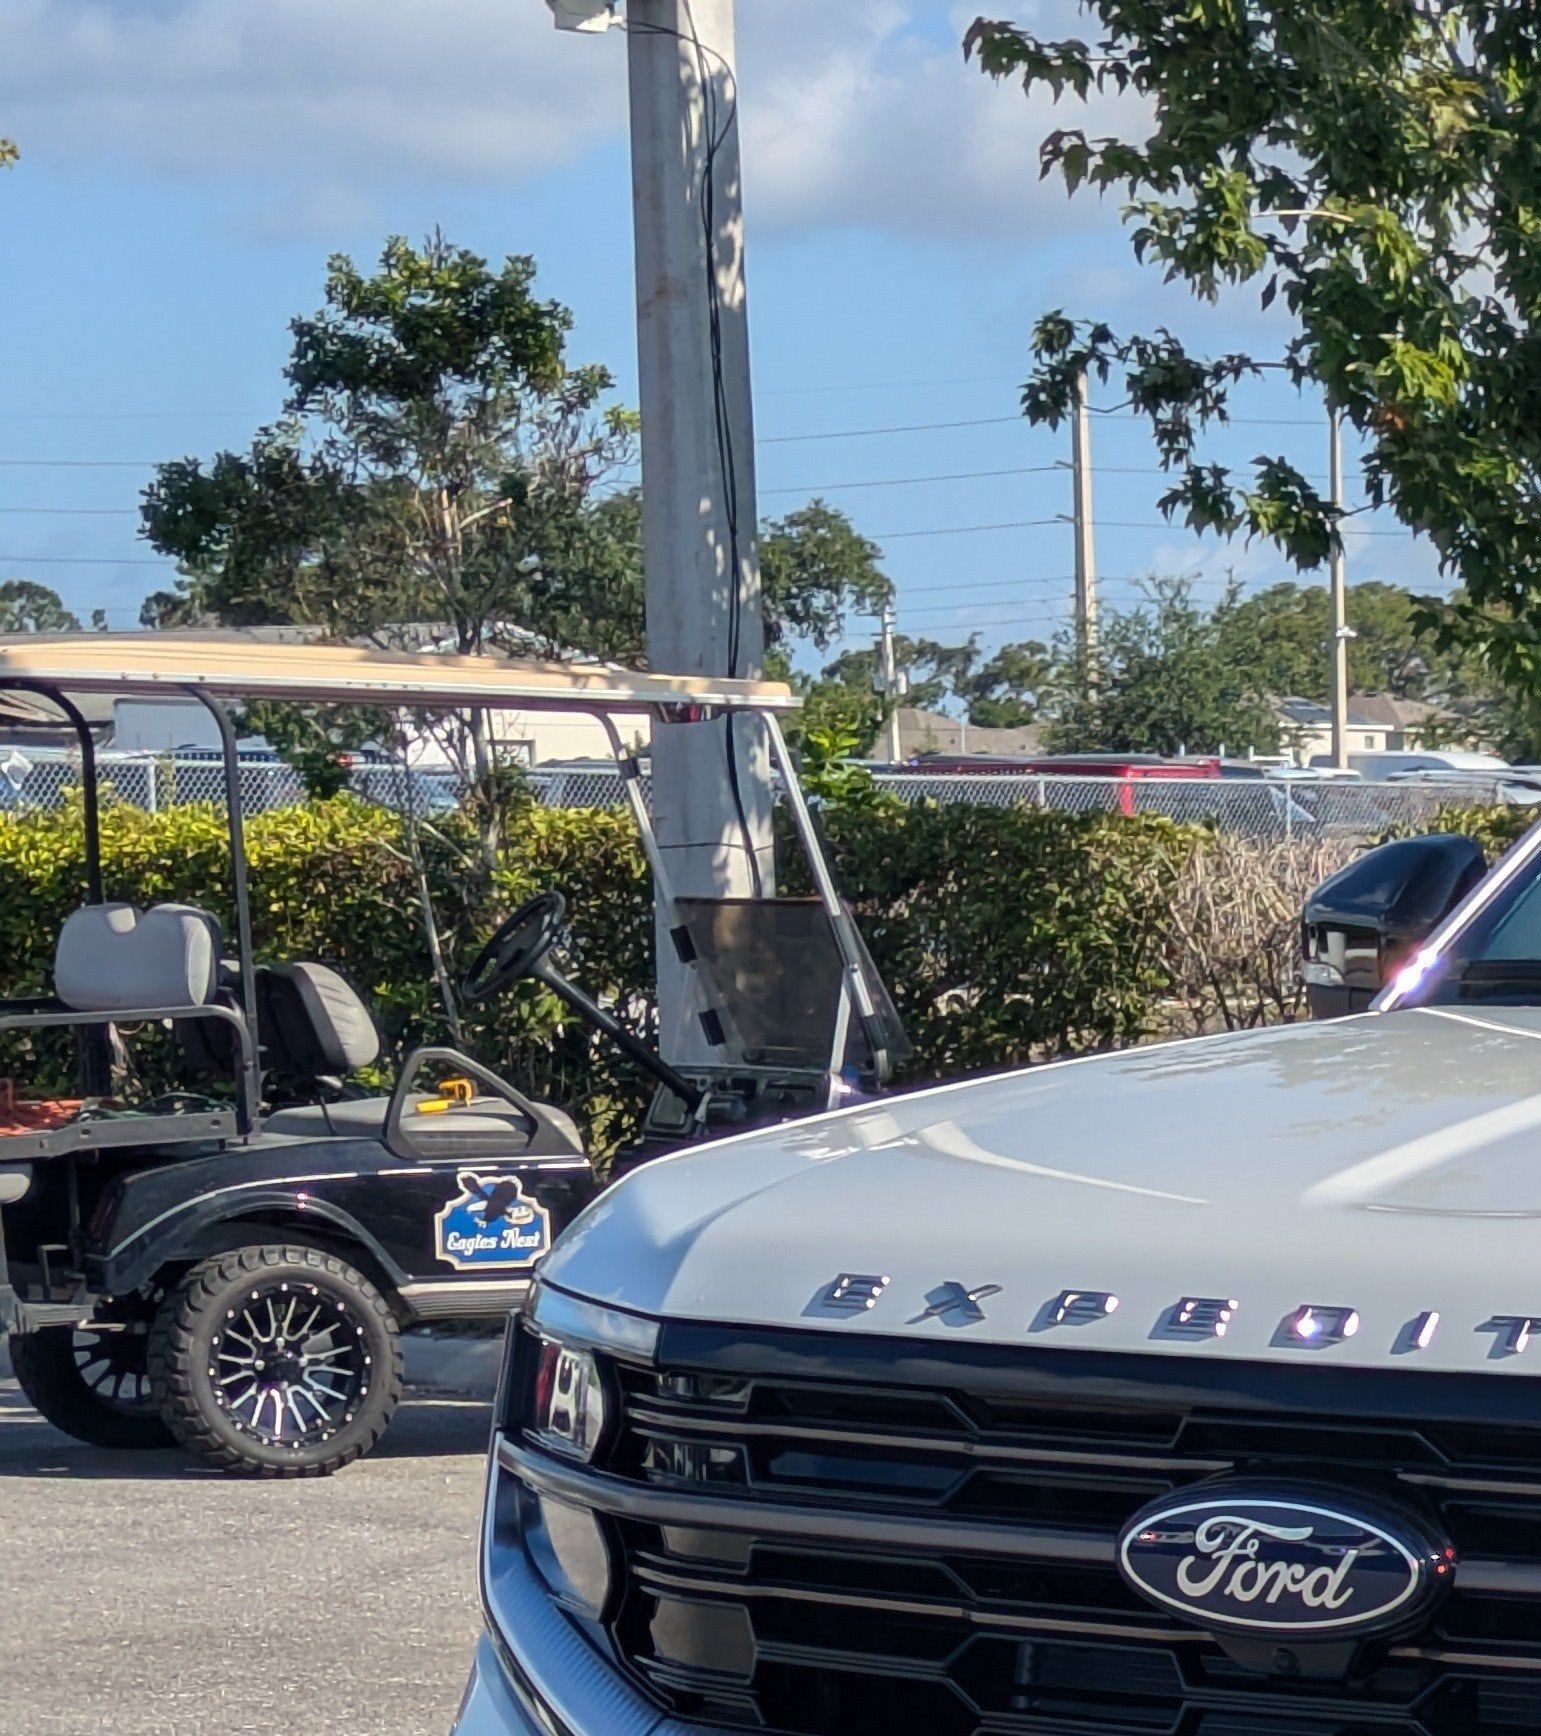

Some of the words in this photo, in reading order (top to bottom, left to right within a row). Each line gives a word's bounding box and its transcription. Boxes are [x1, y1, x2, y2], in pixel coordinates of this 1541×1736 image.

[447, 1232, 498, 1255] Eagles
[501, 1228, 540, 1248] Nest
[1176, 1515, 1358, 1609] Ford
